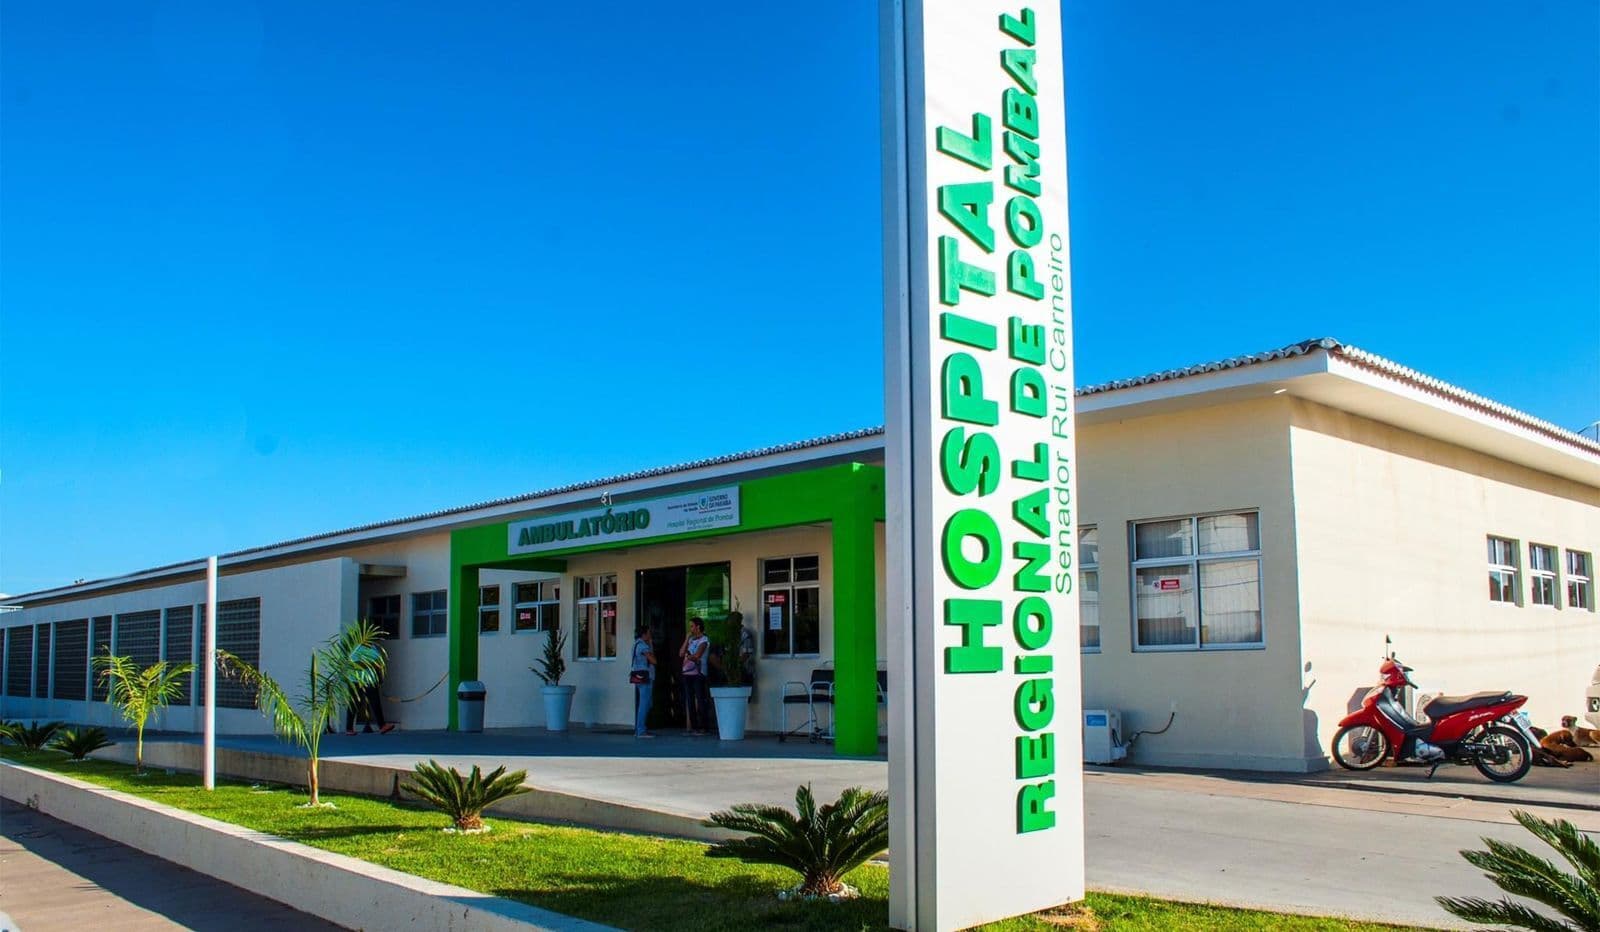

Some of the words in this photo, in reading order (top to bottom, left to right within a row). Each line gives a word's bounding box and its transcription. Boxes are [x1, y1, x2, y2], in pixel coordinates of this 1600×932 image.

[998, 7, 1046, 302] POMBAL
[1008, 315, 1049, 420] DE
[1047, 232, 1067, 373] Carneiro
[936, 111, 1006, 676] HOSPITAL
[1050, 383, 1069, 440] Rui
[517, 507, 652, 547] AMBULATÓRIO
[1053, 449, 1073, 595] Senador
[1011, 441, 1058, 836] REGIONAL
